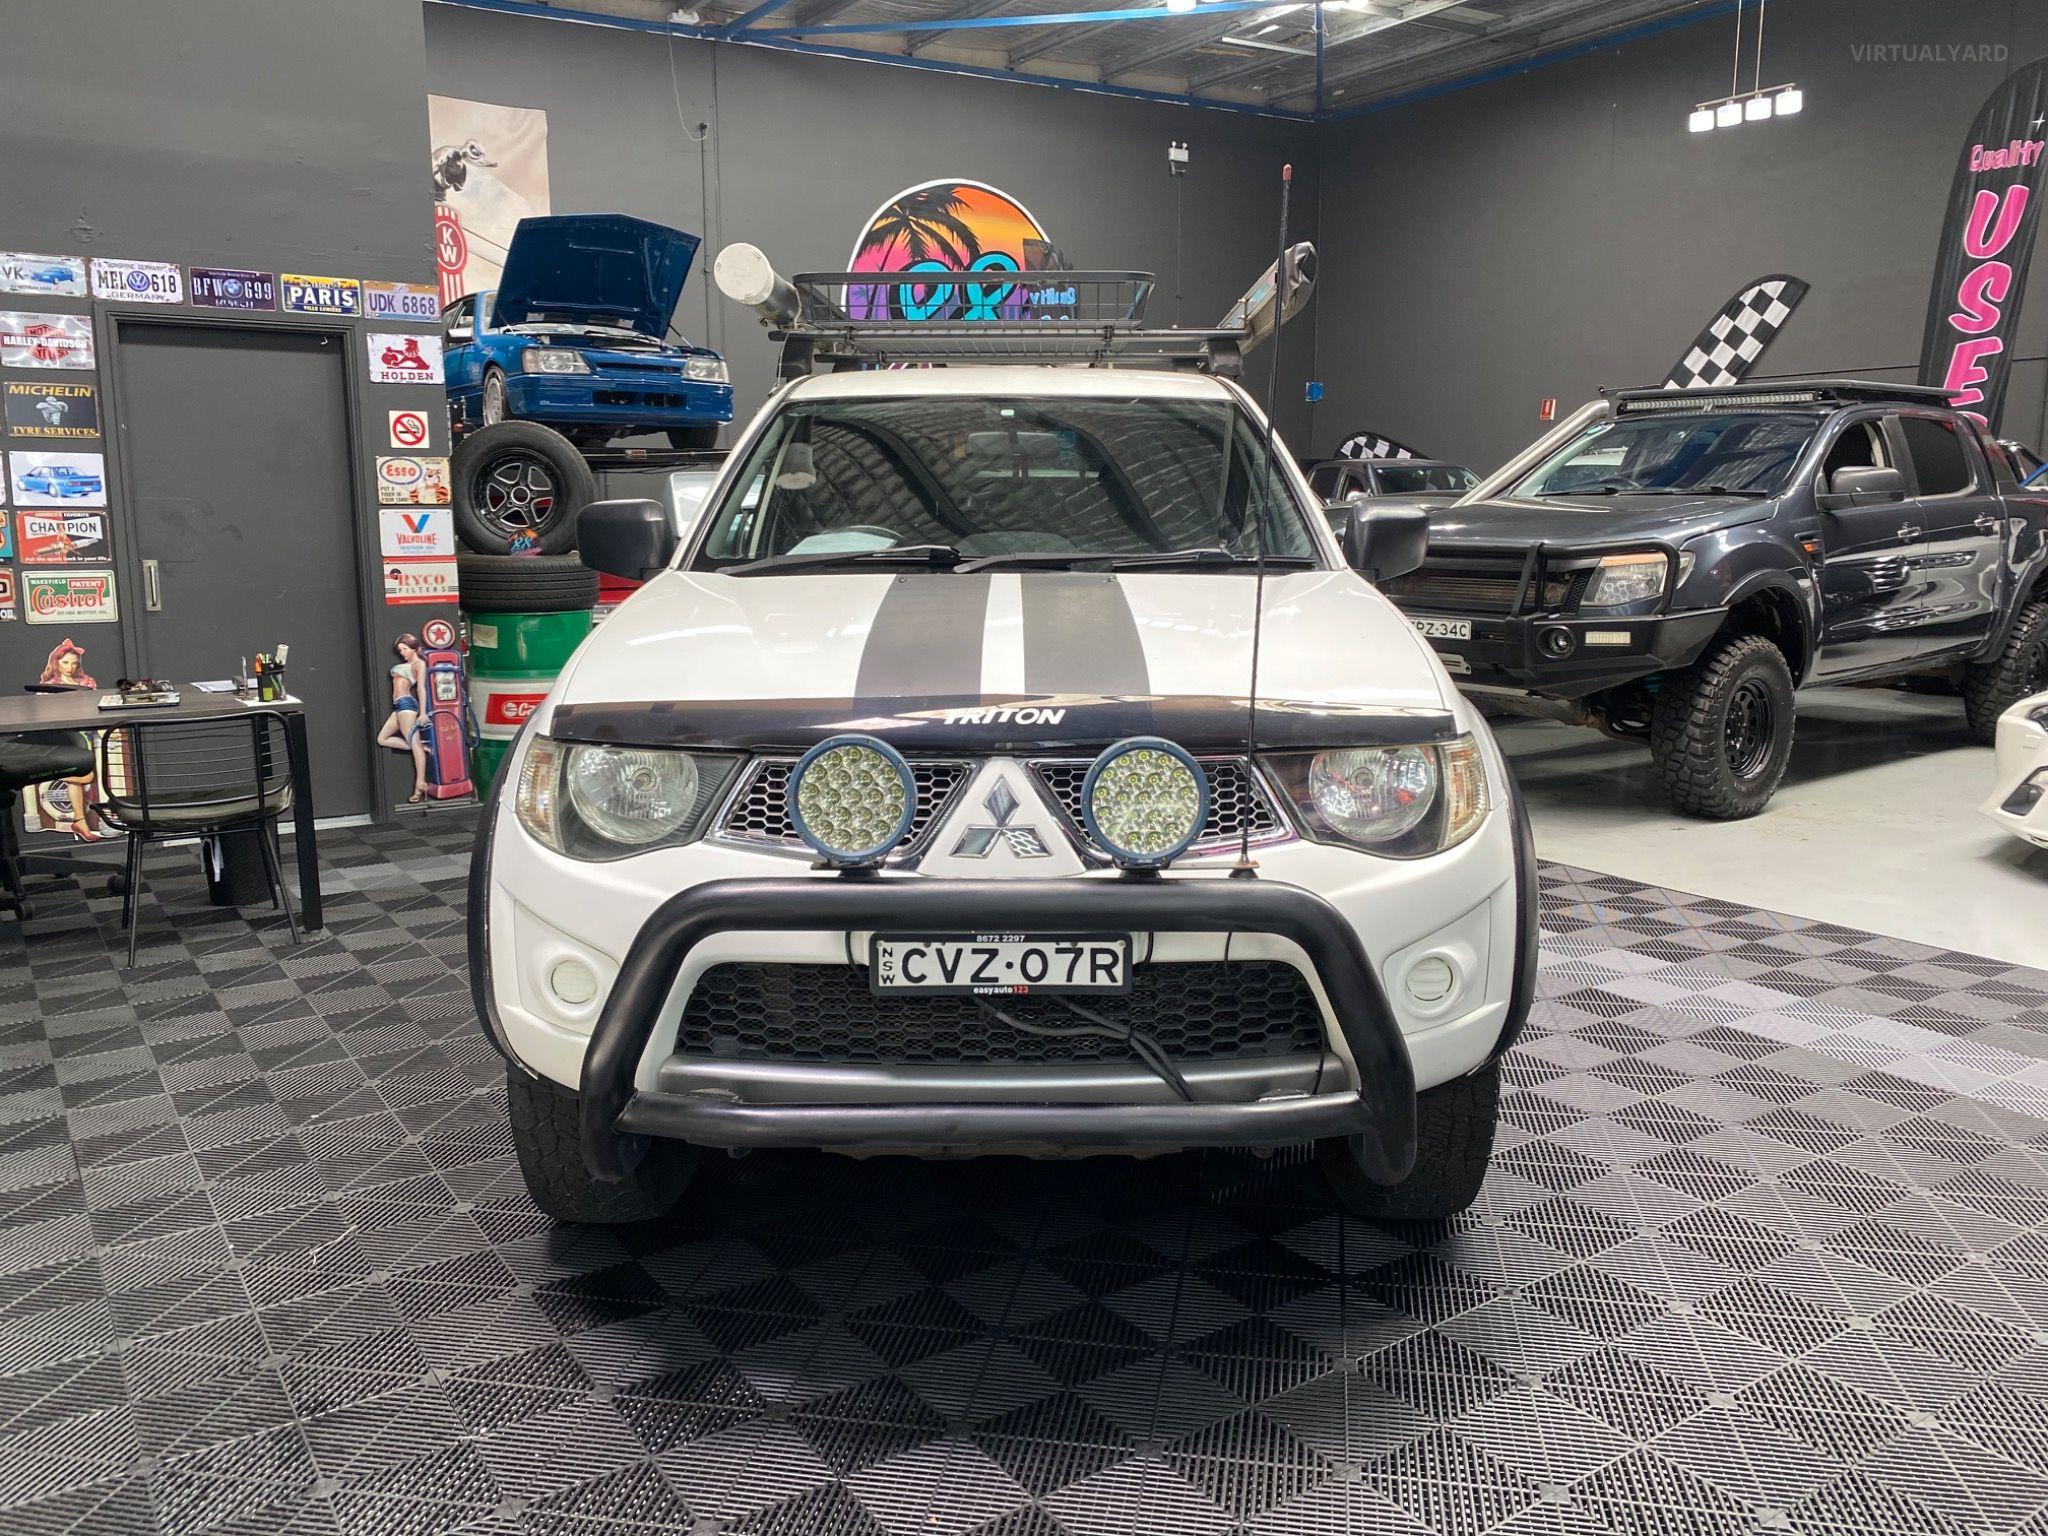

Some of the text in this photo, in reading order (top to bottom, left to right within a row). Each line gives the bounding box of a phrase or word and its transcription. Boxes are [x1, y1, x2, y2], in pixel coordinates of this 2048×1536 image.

[1970, 140, 2045, 172] Quality
[97, 269, 177, 293] MEL 618
[193, 277, 272, 300] BFW 699
[290, 286, 354, 307] PARIS
[369, 292, 435, 315] UDK 6868
[3, 335, 88, 348] HARLEY-DAVIDSON
[381, 371, 434, 381] HOLDEN
[9, 385, 92, 397] MICHELIN
[12, 426, 97, 436] TYRE SERVICES
[396, 533, 437, 545] VALVOLINE
[70, 580, 101, 588] PATENT
[399, 574, 446, 586] RYCO
[32, 584, 106, 615] Castrol
[944, 708, 1067, 725] TRITON
[976, 935, 1026, 943] 8672 2297
[973, 985, 1029, 995] easyauto123
